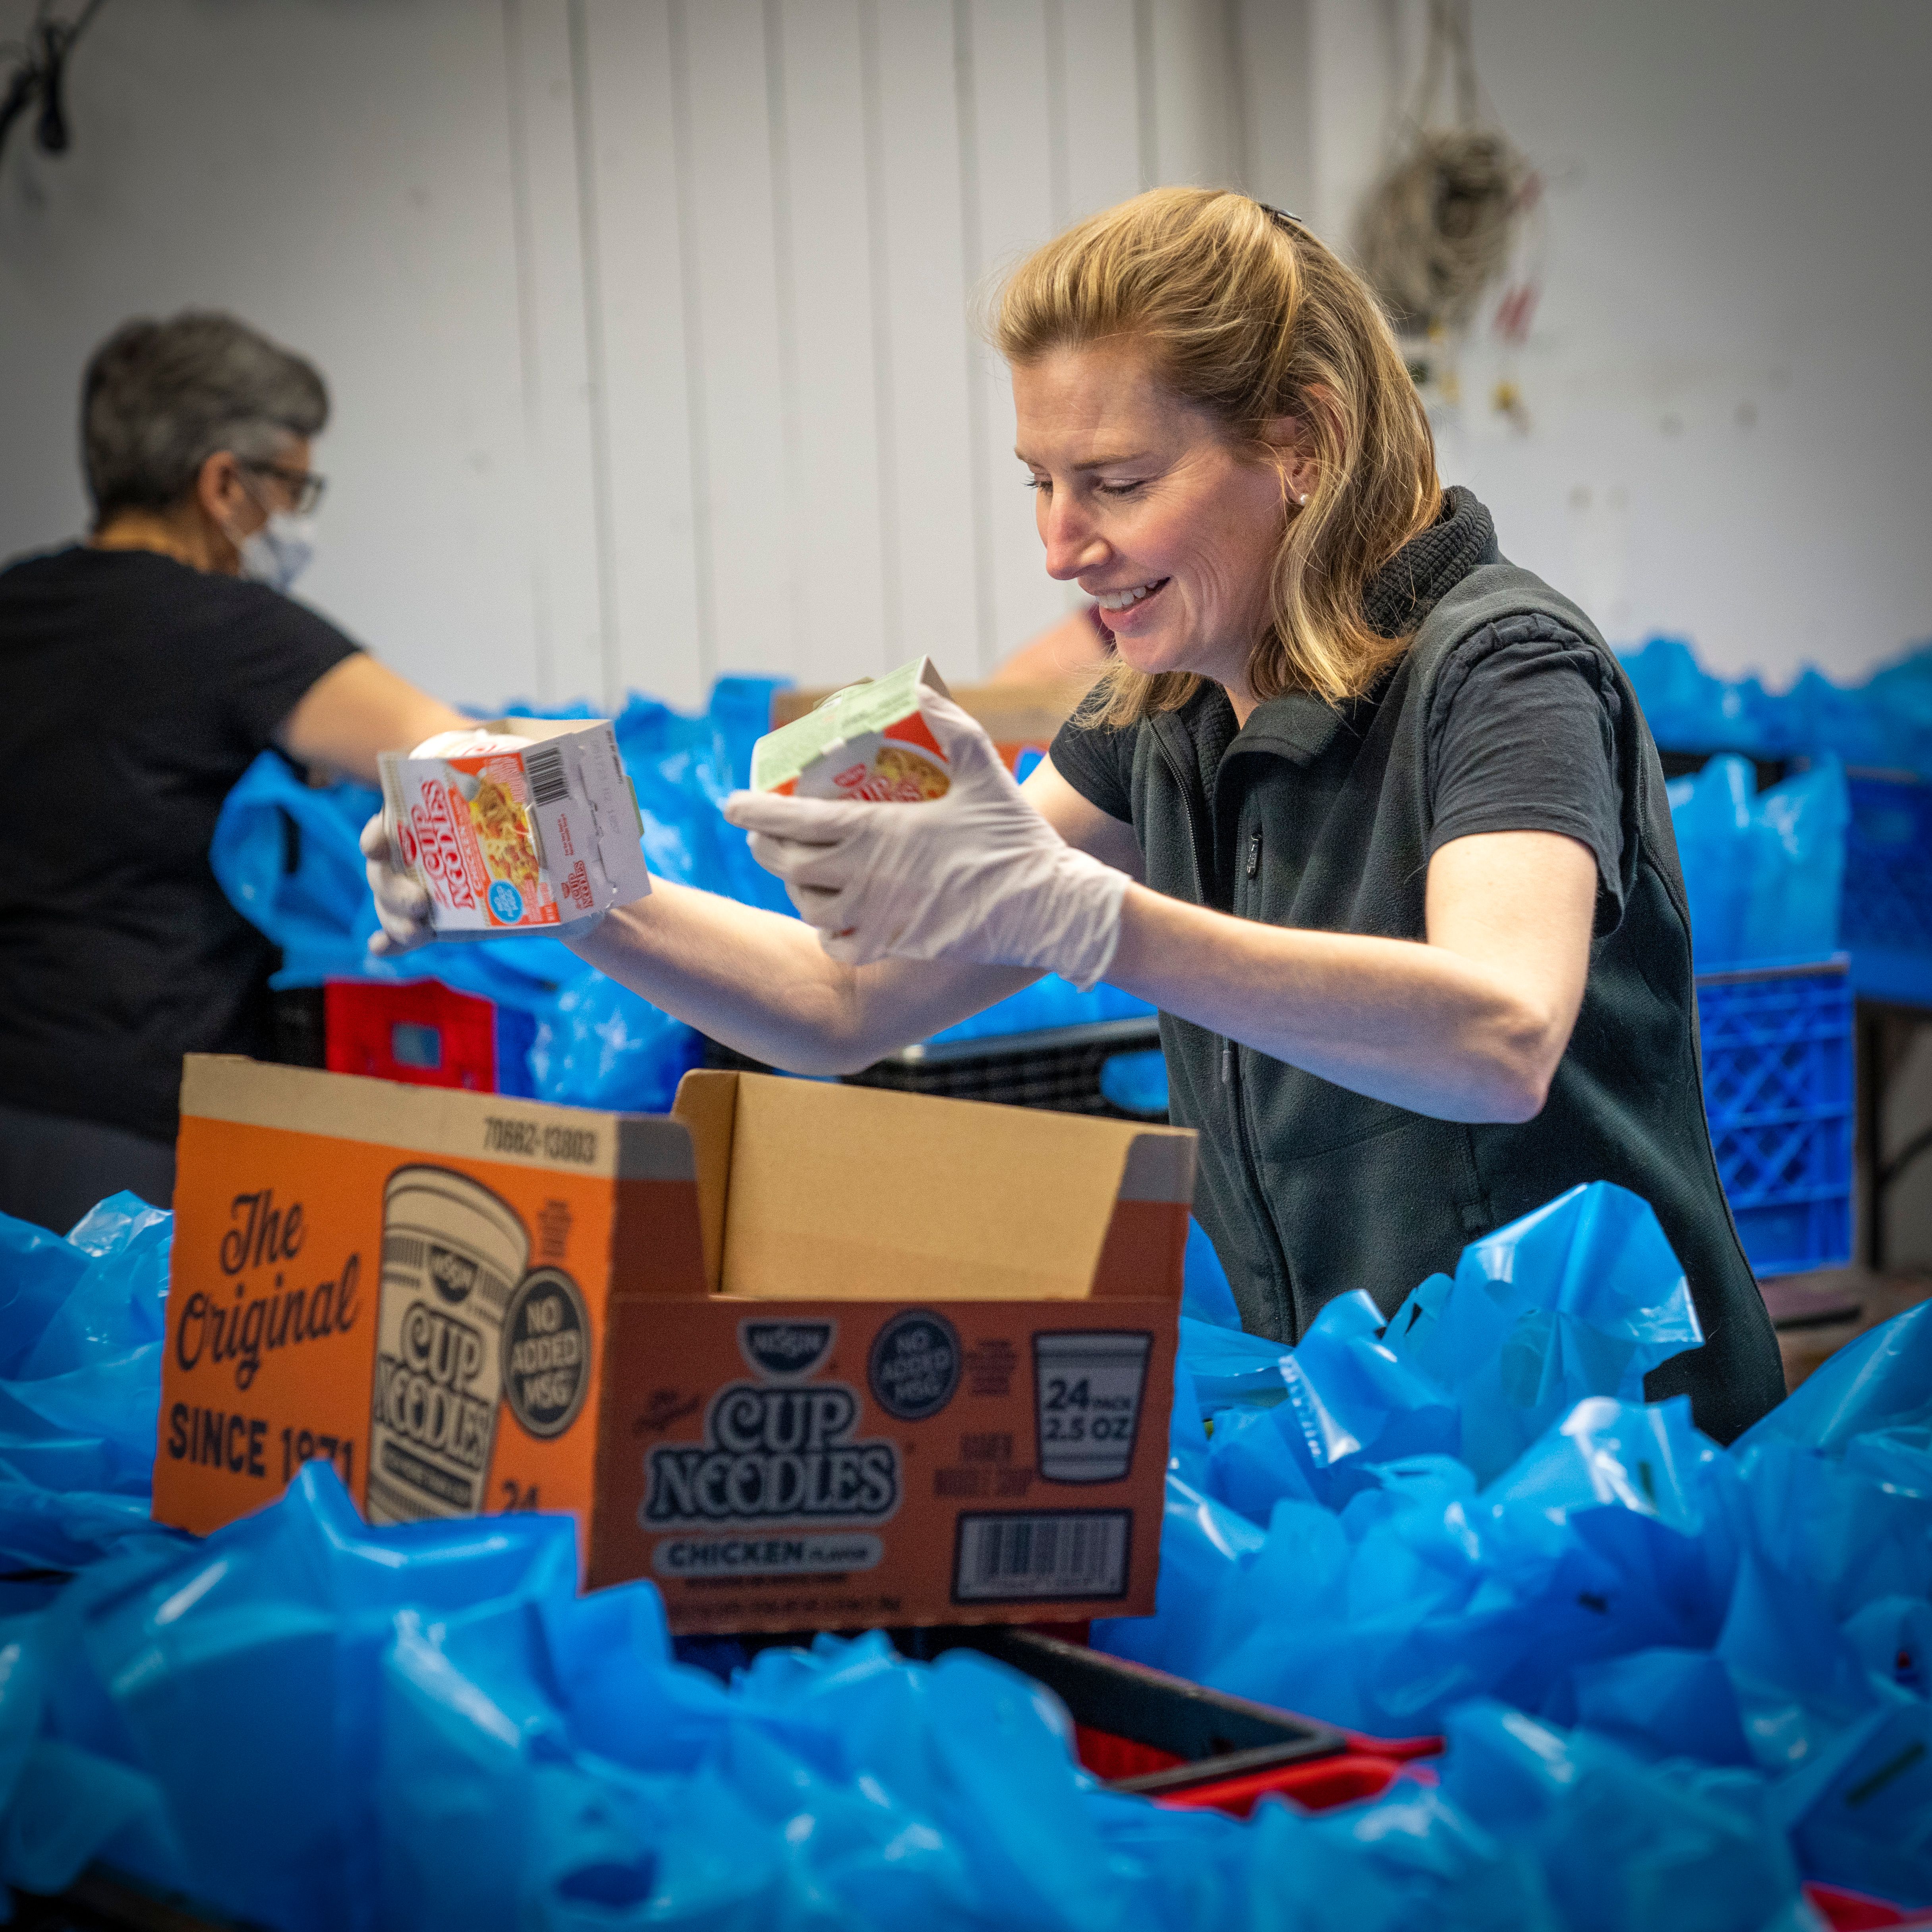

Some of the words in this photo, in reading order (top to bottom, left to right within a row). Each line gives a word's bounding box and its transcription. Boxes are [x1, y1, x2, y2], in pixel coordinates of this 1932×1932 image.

[412, 804, 446, 880] CUP
[421, 779, 476, 910] NOODLES
[219, 1188, 307, 1276] The
[176, 1252, 361, 1390] Original
[400, 1300, 490, 1392] CUP
[526, 1296, 563, 1335] NO
[895, 1327, 931, 1354] NO
[510, 1329, 581, 1376] ADDED
[523, 1370, 574, 1409] MSG
[714, 1385, 856, 1455] CUP
[1045, 1378, 1090, 1411] 24
[168, 1401, 269, 1479] SINCE
[1045, 1416, 1085, 1441] 2.5
[1090, 1416, 1130, 1440] OZ
[644, 1442, 897, 1520] NOODLES
[667, 1540, 805, 1567] CHICKEN
